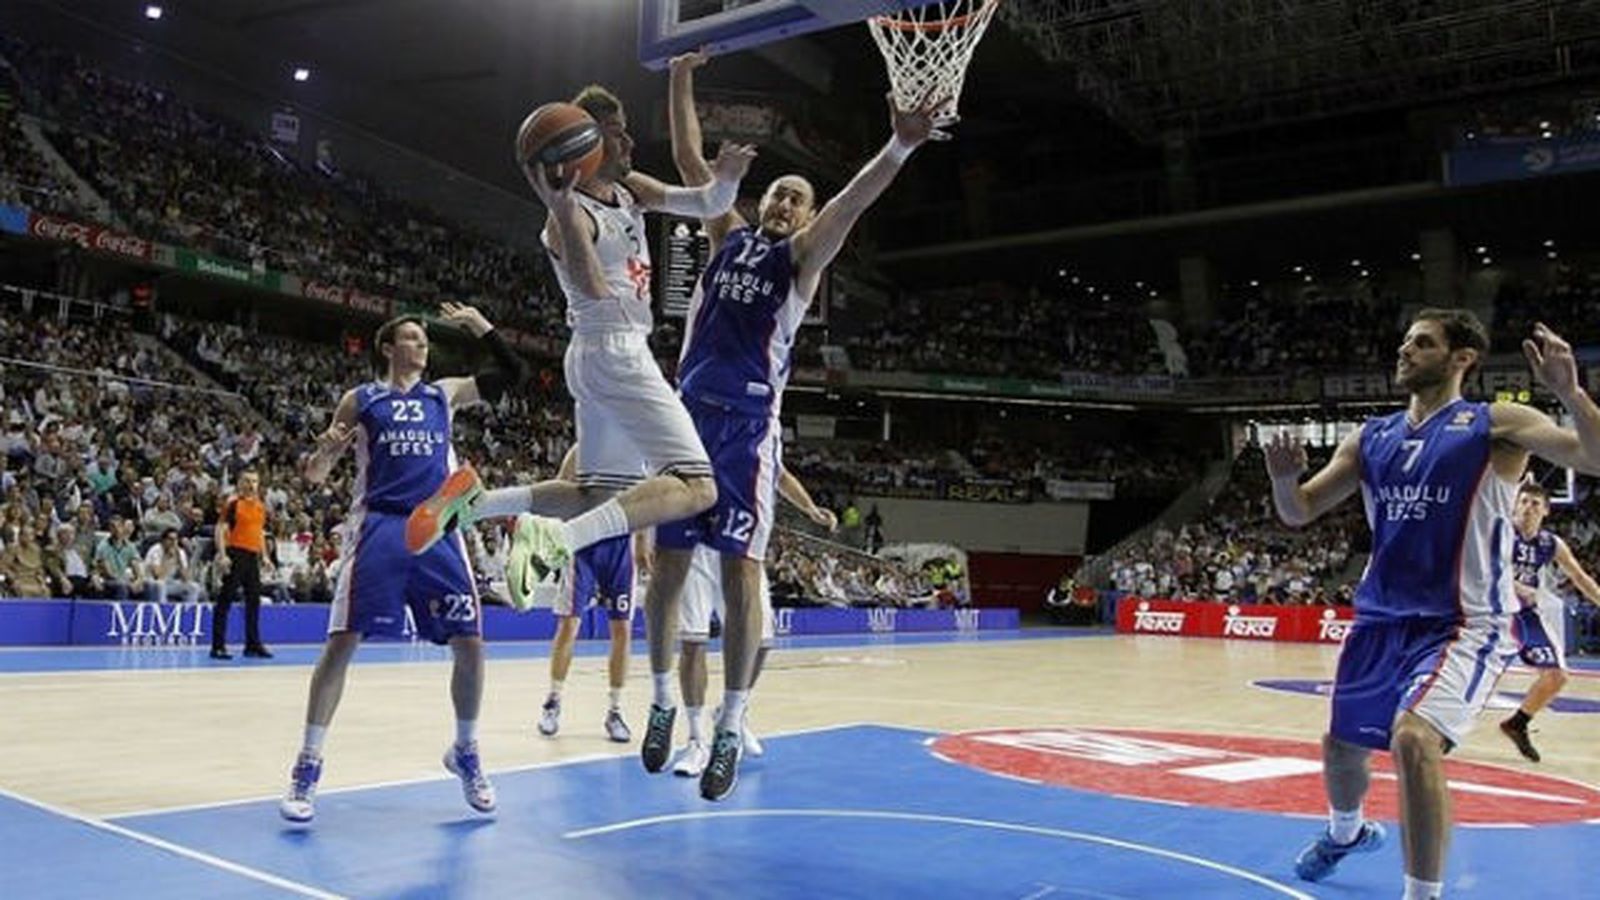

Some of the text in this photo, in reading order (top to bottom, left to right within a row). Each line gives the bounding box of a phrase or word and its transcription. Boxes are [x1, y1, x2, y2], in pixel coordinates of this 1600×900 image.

[734, 237, 770, 268] 12
[719, 284, 755, 304] EFES
[391, 400, 425, 422] 23
[377, 429, 444, 444] ANADOLU
[390, 442, 433, 457] EFES
[1401, 439, 1425, 473] 7
[1375, 485, 1451, 504] NADOLU
[721, 507, 755, 542] 12
[1517, 543, 1536, 563] 31
[444, 593, 476, 621] 23
[616, 593, 629, 612] 6
[107, 602, 214, 636] MMT
